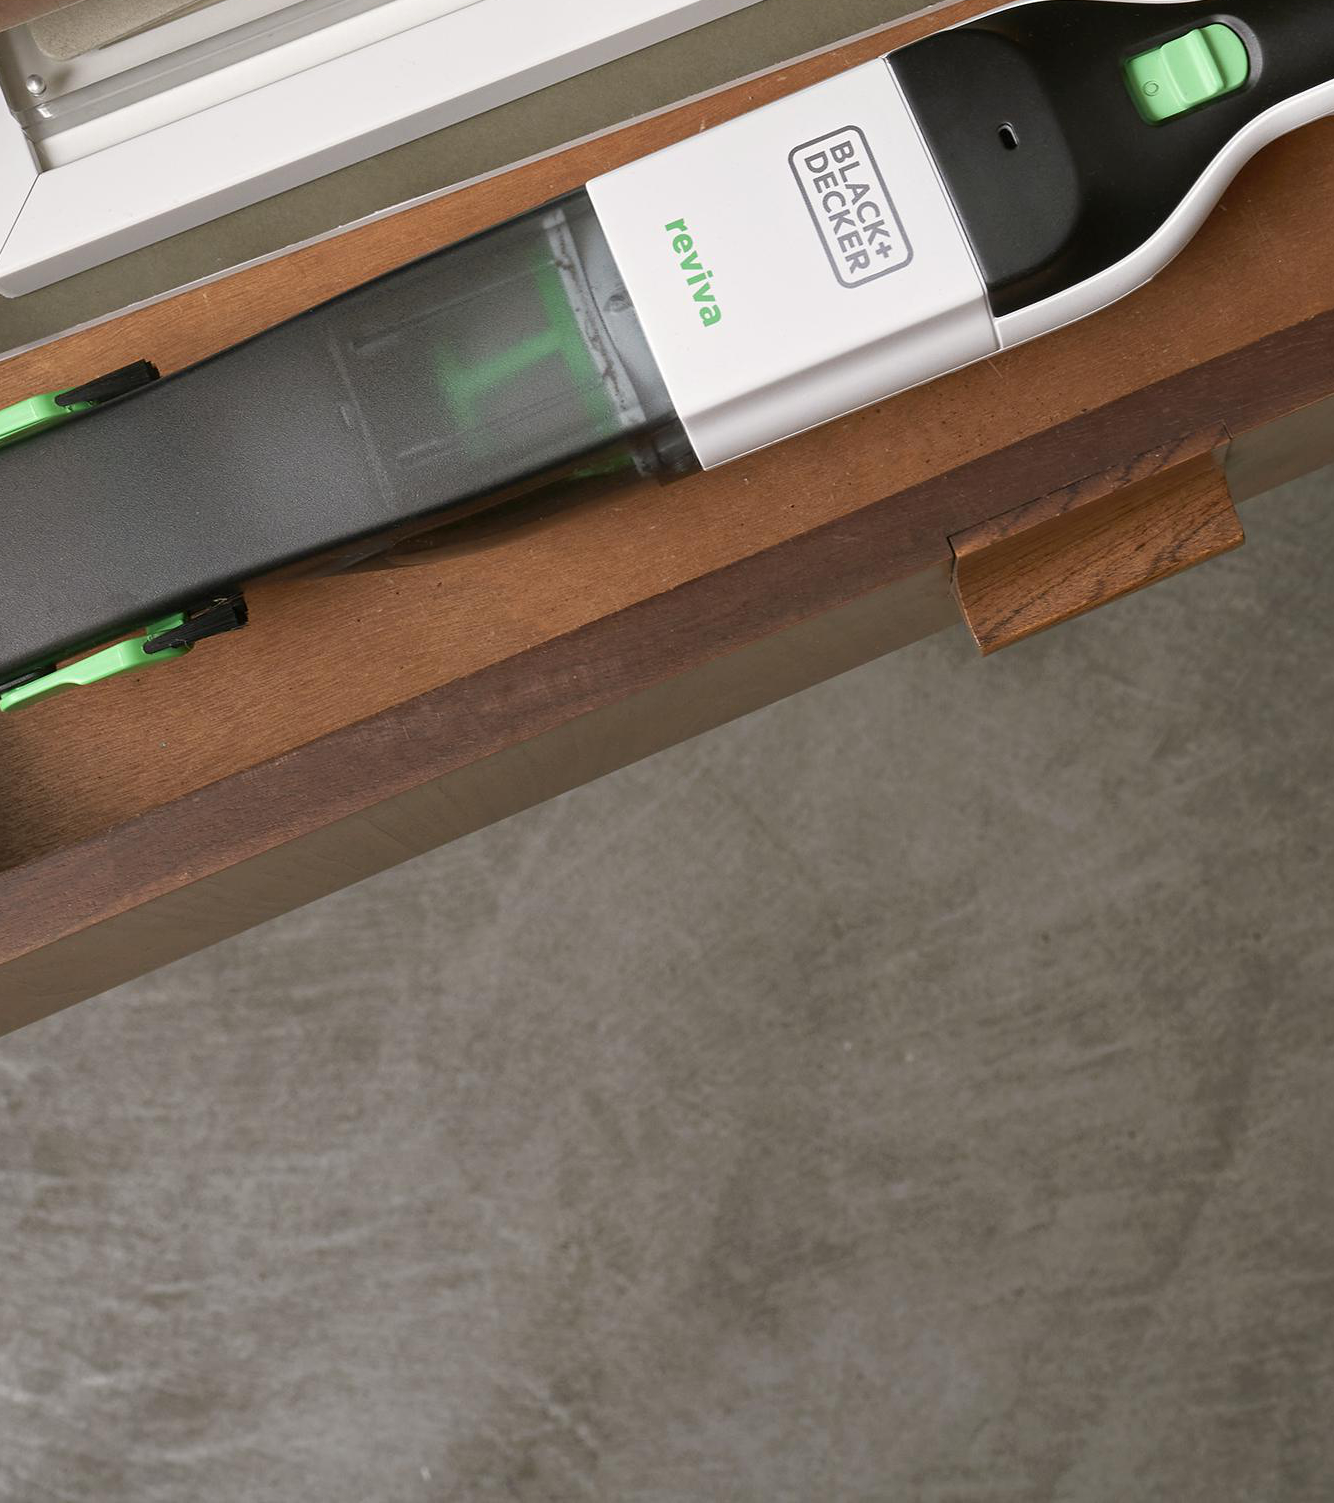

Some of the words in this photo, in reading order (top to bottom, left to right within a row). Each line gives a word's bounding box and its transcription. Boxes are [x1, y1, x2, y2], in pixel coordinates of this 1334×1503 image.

[802, 149, 871, 275] DECKER
[828, 139, 894, 260] BLACK+
[664, 217, 722, 327] reviva
